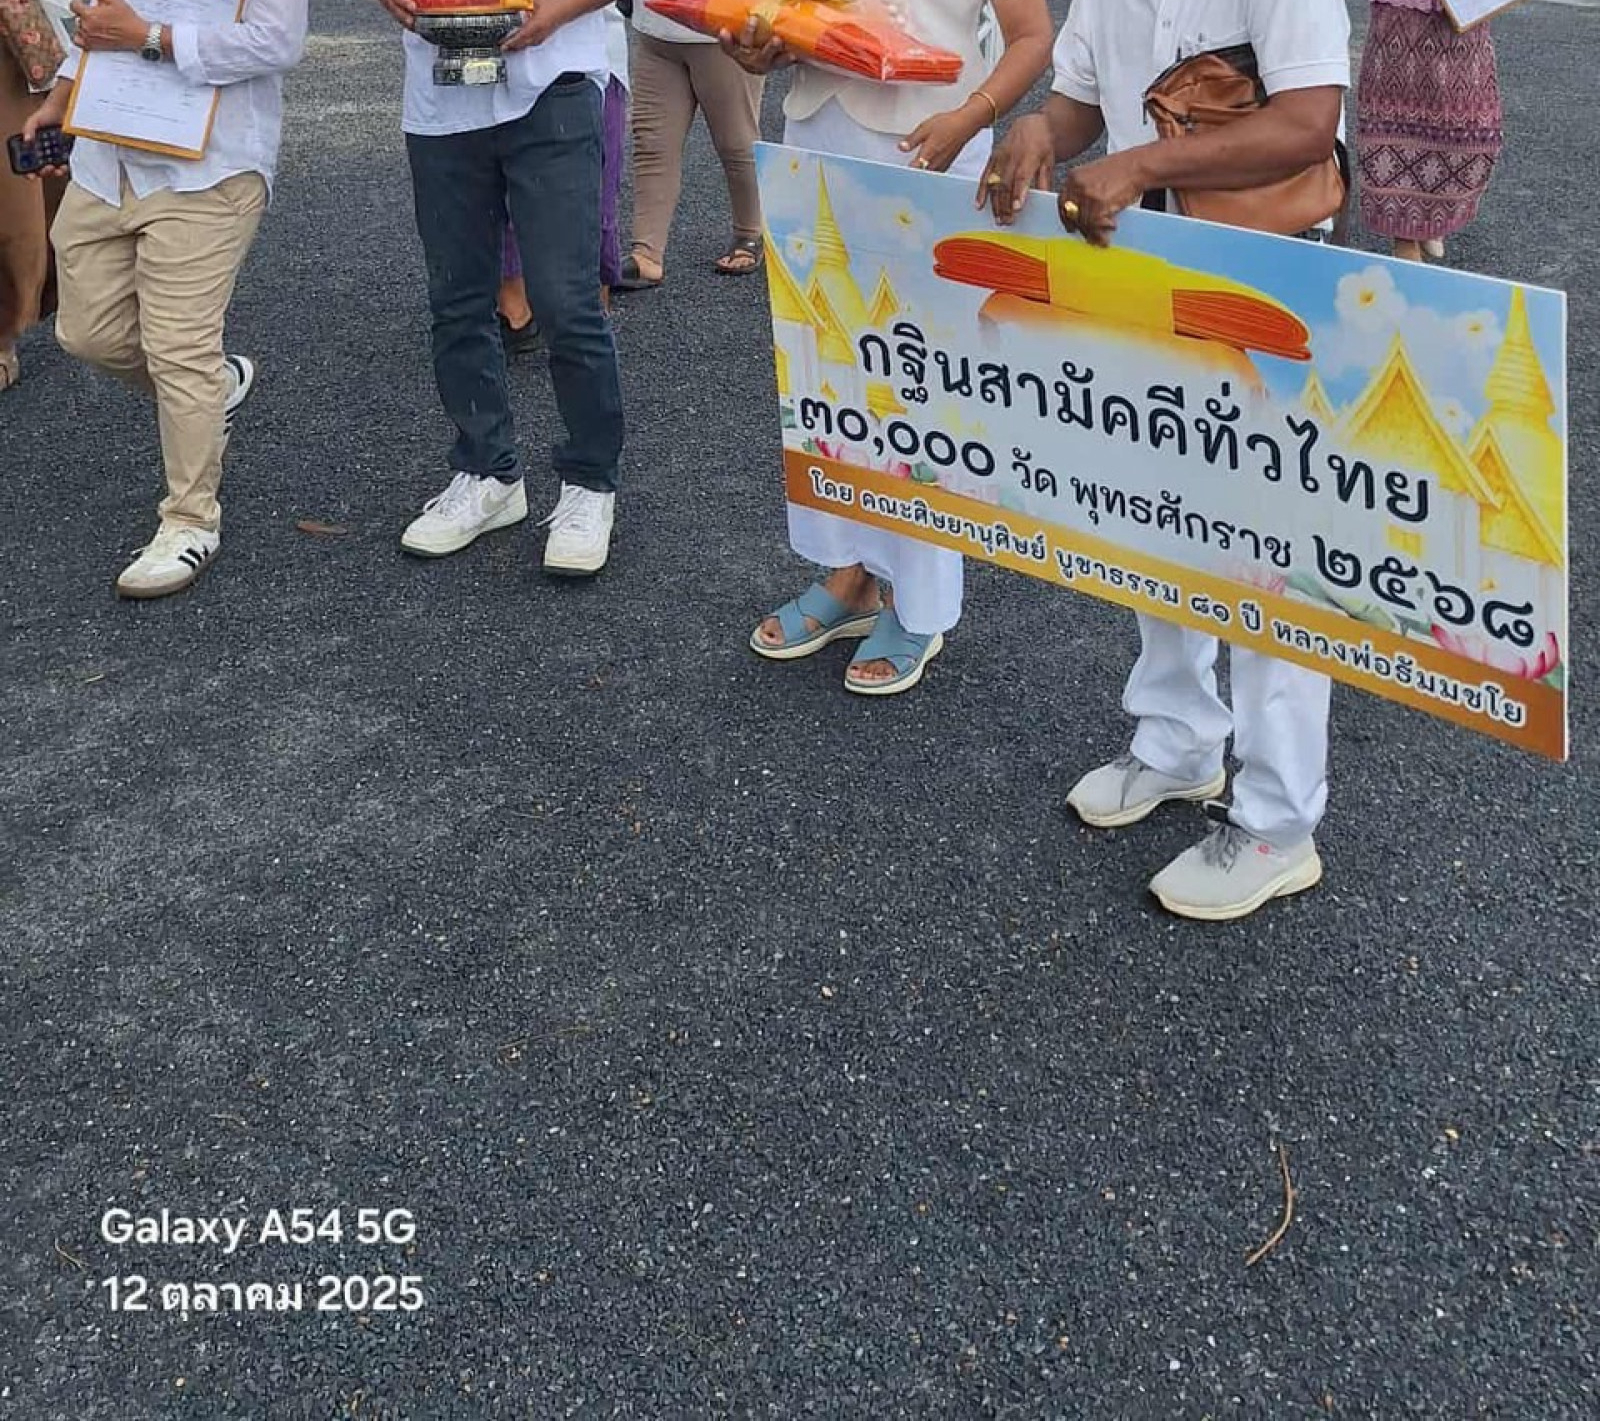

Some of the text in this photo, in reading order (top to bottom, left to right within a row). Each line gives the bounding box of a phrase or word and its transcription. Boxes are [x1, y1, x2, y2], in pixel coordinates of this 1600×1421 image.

[800, 397, 1534, 647] ๓๐,๐๐๐ วัด พุทธศักราช ๒๕๖๘
[859, 322, 1429, 522] กฐินสามัคคีทั่วไทย
[810, 469, 853, 502] โดย
[862, 491, 1045, 560] คณะศิษยานุศิษย์
[1191, 597, 1230, 622] ๘๑
[1241, 602, 1261, 631] ปี
[1273, 620, 1523, 723] หลวงพ่อธัมมชโย
